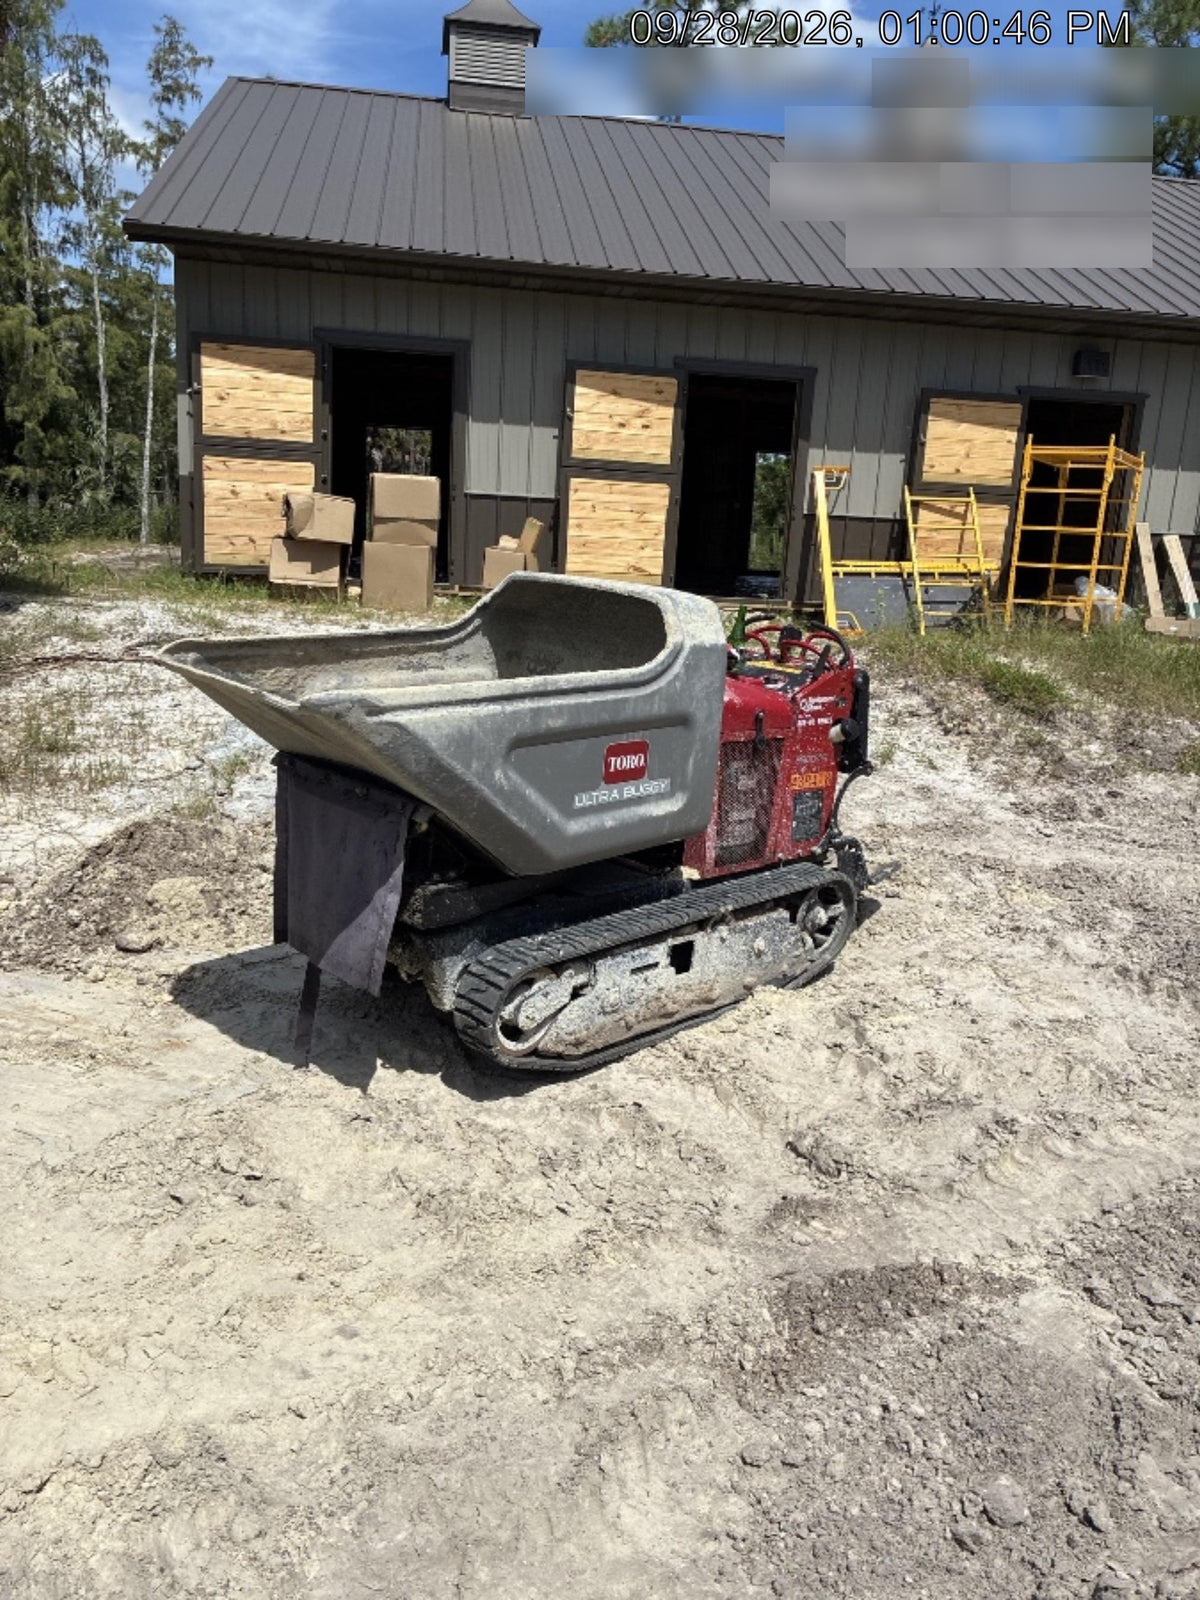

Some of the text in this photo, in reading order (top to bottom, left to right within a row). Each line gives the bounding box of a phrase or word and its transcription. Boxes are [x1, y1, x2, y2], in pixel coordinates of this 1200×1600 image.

[608, 753, 645, 772] TORO
[574, 778, 668, 808] ULTRA BUGGY
